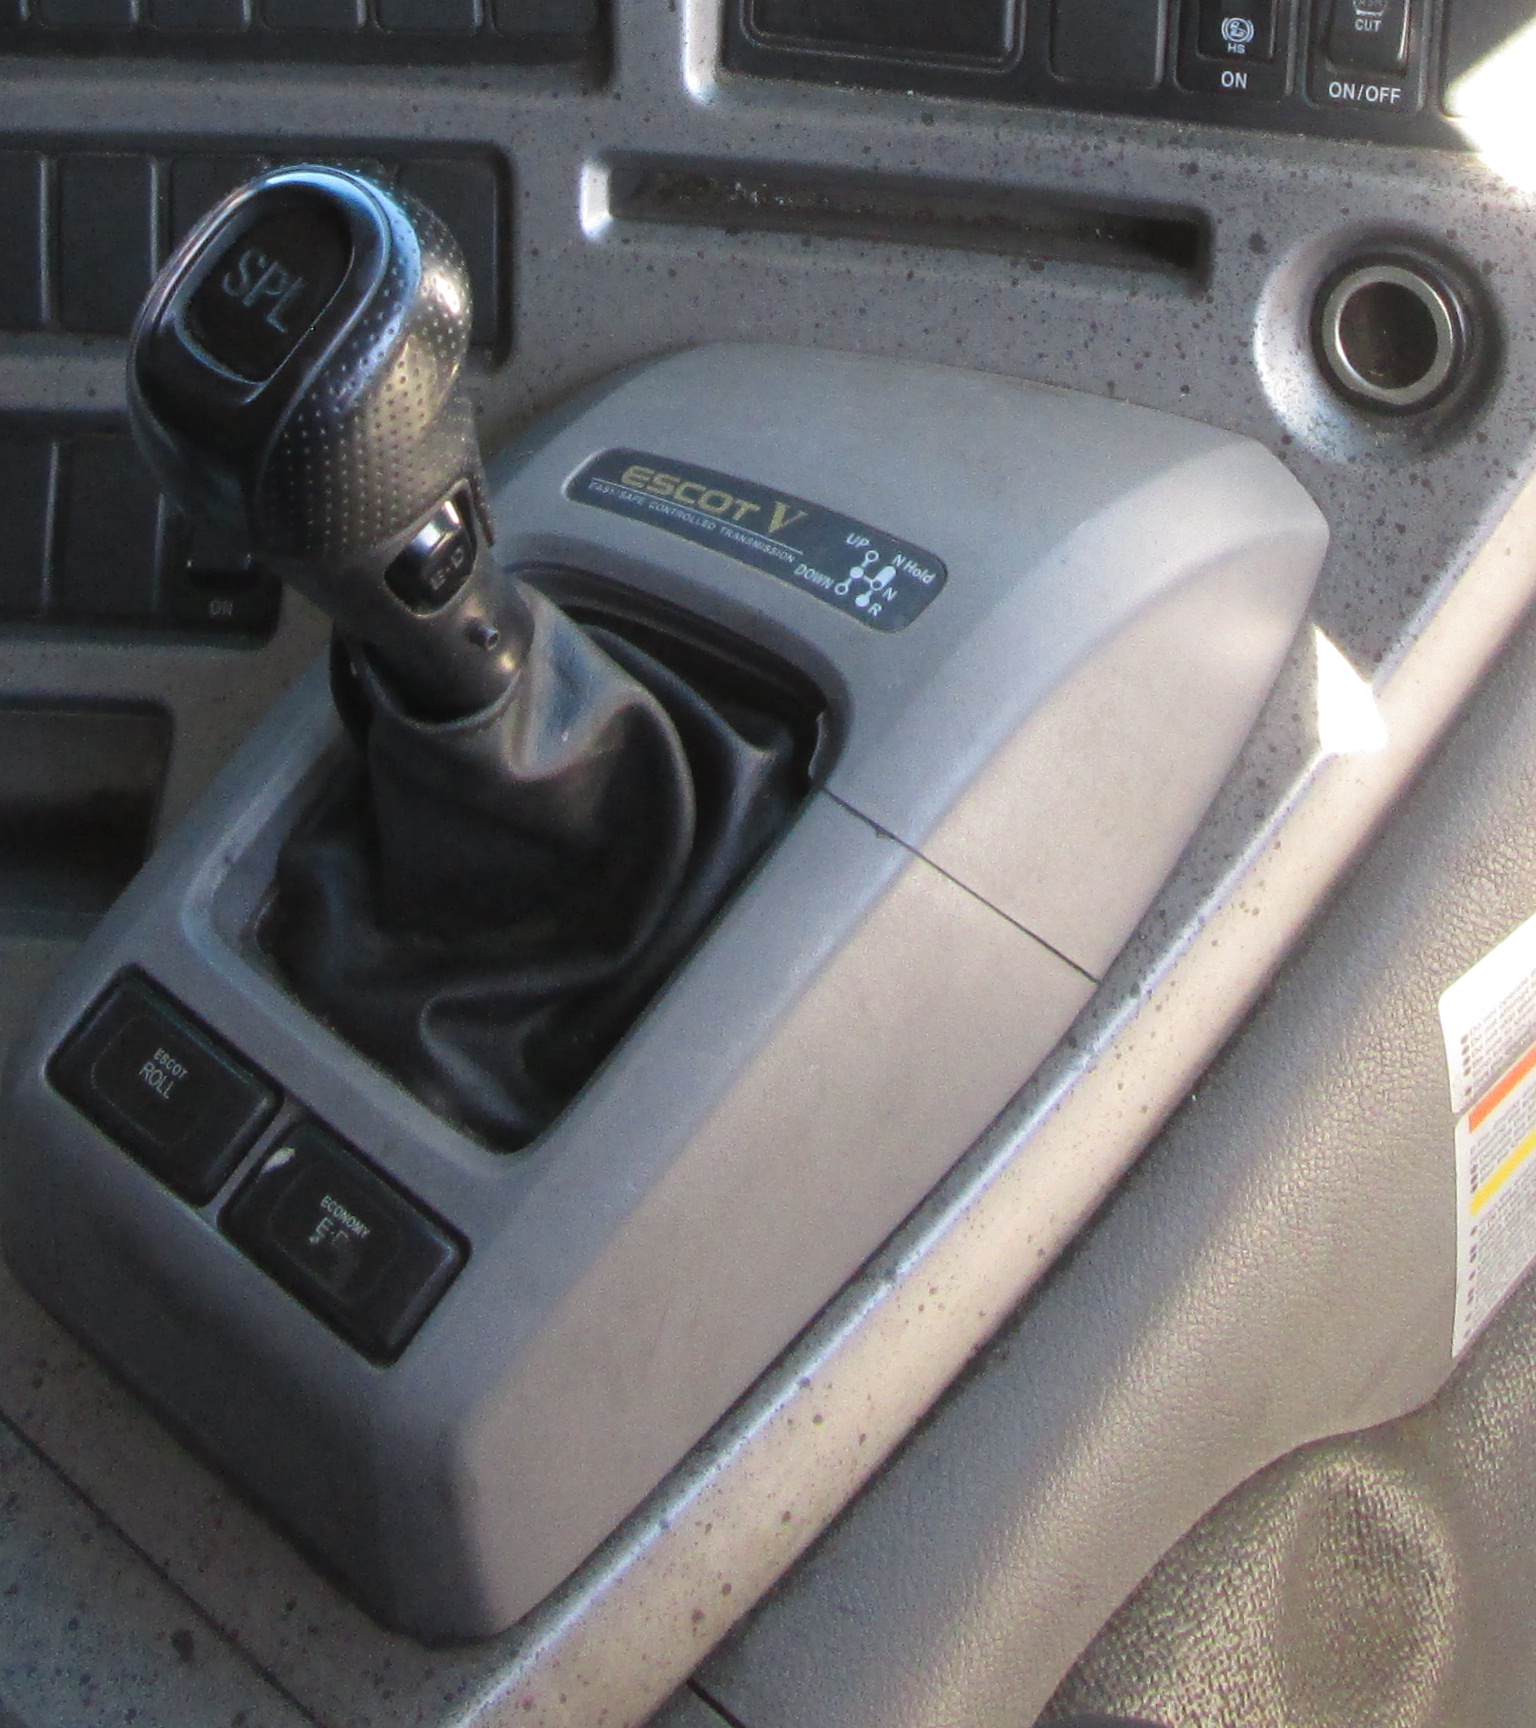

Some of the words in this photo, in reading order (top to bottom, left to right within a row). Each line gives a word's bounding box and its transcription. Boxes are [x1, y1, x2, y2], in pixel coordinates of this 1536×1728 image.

[1354, 18, 1382, 32] CUT
[1227, 43, 1246, 54] HS
[1221, 71, 1248, 89] ON
[1328, 81, 1402, 104] ON/OFF
[621, 465, 761, 521] ESCOT
[768, 500, 809, 536] V
[648, 500, 717, 532] CONTROLLED
[846, 533, 870, 548] UP
[794, 564, 836, 590] DOWN
[892, 553, 907, 568] N
[903, 560, 937, 585] Hold
[882, 587, 899, 602] N
[868, 602, 883, 617] R
[154, 1047, 188, 1079] ESCOT
[138, 1060, 175, 1100] ROLL
[320, 1195, 371, 1239] ECONOMY
